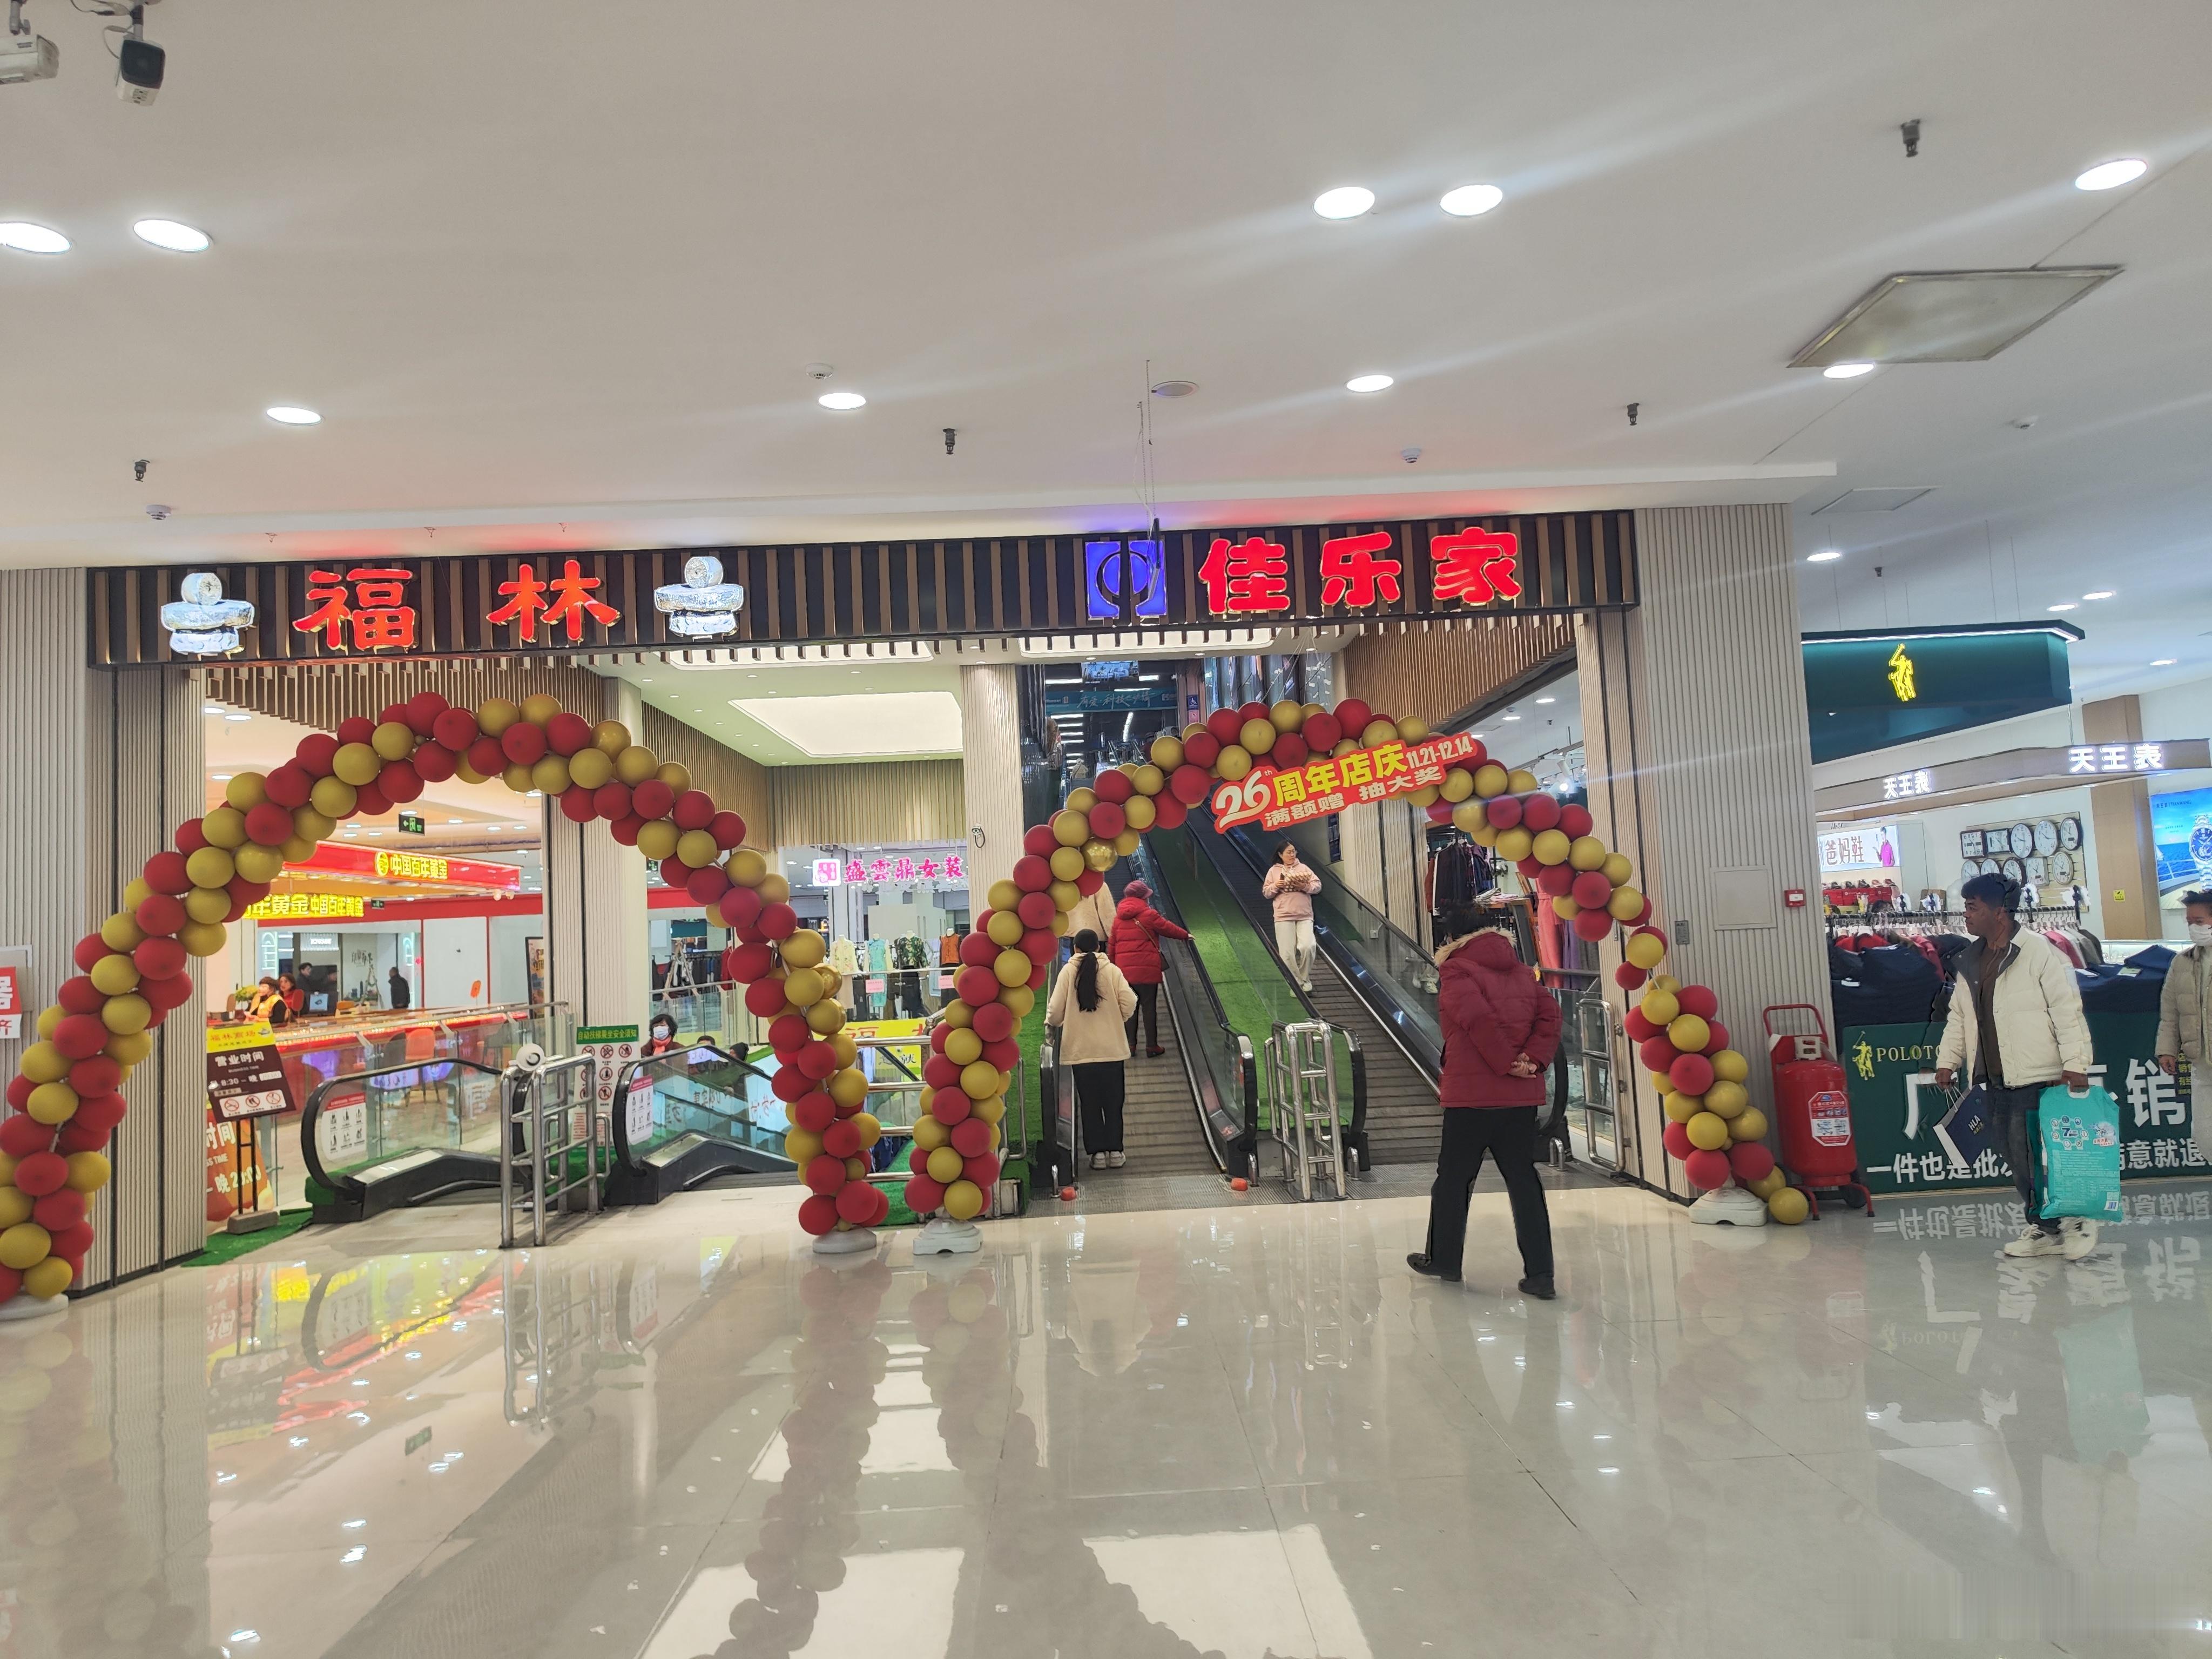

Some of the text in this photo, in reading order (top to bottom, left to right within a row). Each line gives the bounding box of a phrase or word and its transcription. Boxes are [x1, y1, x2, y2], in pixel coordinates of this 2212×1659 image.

[1198, 526, 1523, 615] 佳乐家
[292, 559, 622, 651] 福林
[1406, 735, 1473, 770] 11.21-12.14
[2069, 743, 2163, 772] 天王表
[1883, 770, 1930, 799] 天王表
[1819, 835, 1864, 866] 爸妈鞋
[214, 1050, 265, 1068] 营业时间
[1876, 1046, 1940, 1062] POLOT
[1968, 1115, 1981, 1131] HLA
